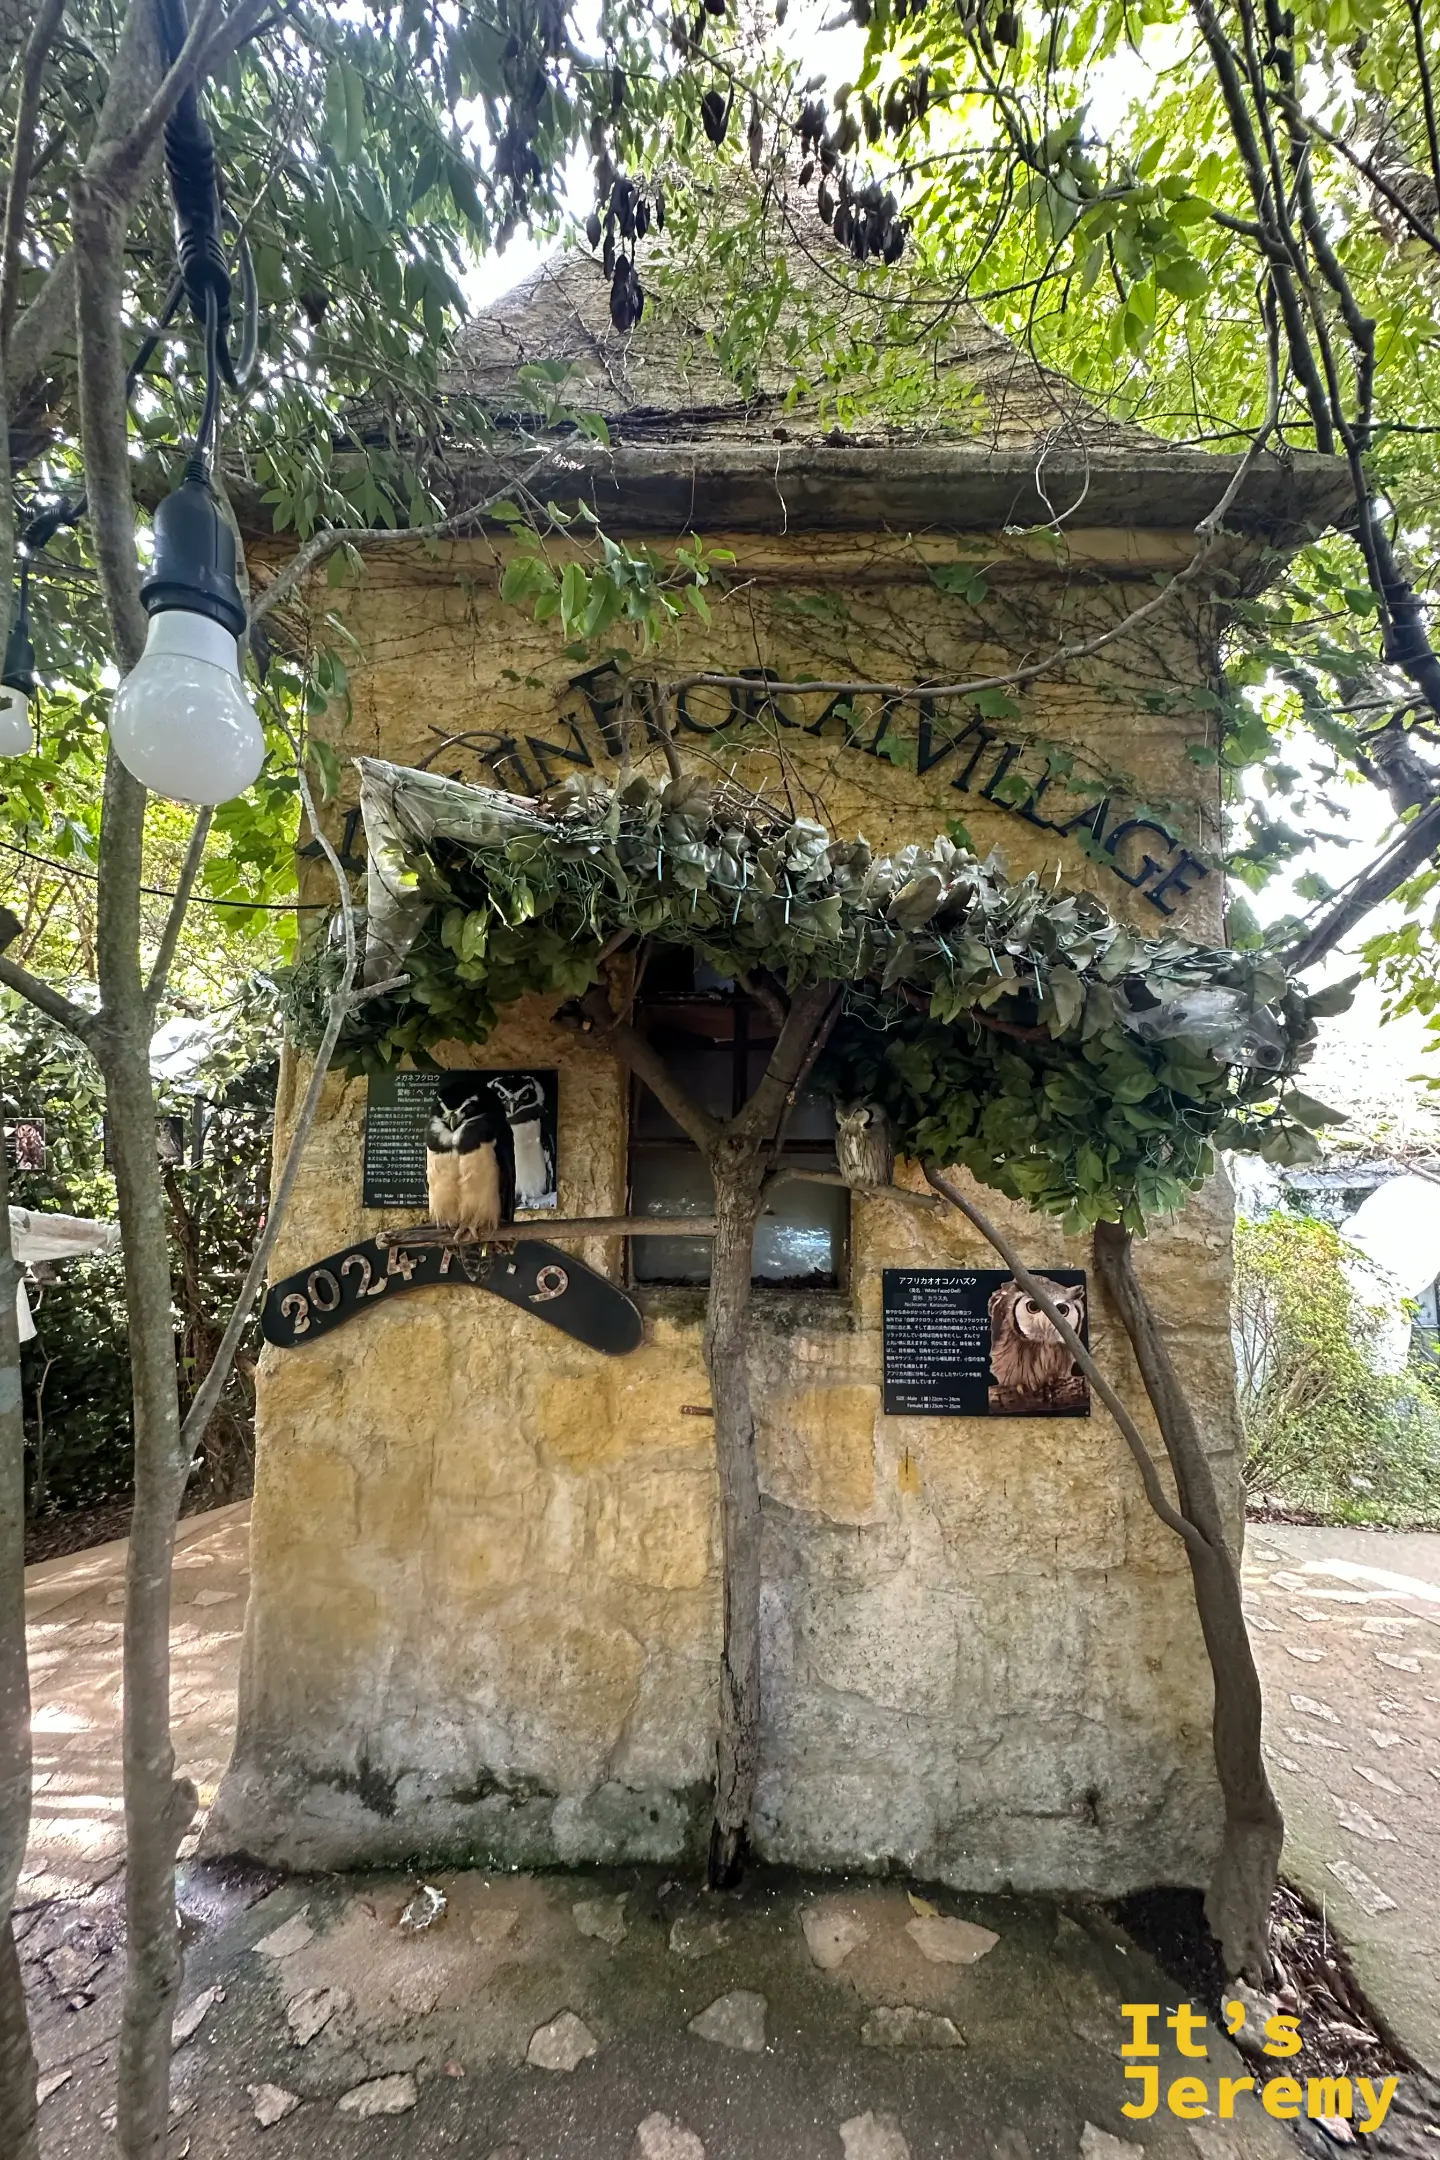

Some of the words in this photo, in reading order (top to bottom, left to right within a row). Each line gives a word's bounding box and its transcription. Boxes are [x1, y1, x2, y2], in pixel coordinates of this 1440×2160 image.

[913, 675, 1210, 916] VILLAGE
[898, 1277, 977, 1285] アフリカオオコノハズク
